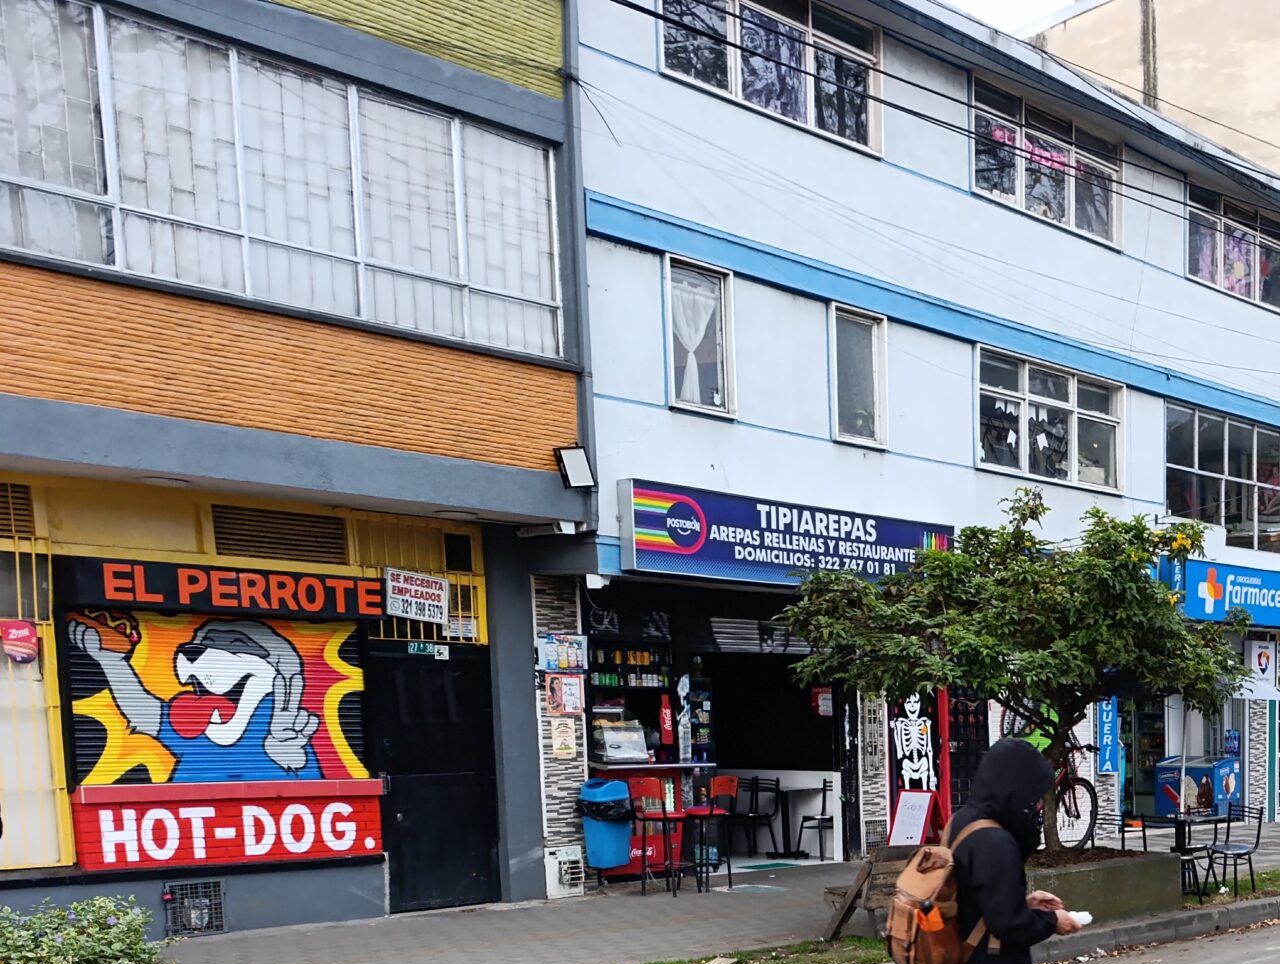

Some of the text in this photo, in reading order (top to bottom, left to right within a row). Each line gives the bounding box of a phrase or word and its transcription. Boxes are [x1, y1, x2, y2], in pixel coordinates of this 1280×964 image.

[757, 503, 876, 542] TIPIAREPAS
[709, 524, 916, 563] AREPAS RELLENAS Y RESTAURANTE
[734, 545, 896, 575] DOMICILIOS: 322 747 01 81
[102, 563, 382, 616] EL PERROTE
[390, 572, 444, 592] SE NECESITA
[391, 585, 442, 602] EMPLEADOS
[401, 599, 412, 615] 321
[427, 603, 444, 620] 5379
[99, 802, 376, 863] HOT-DOG.
